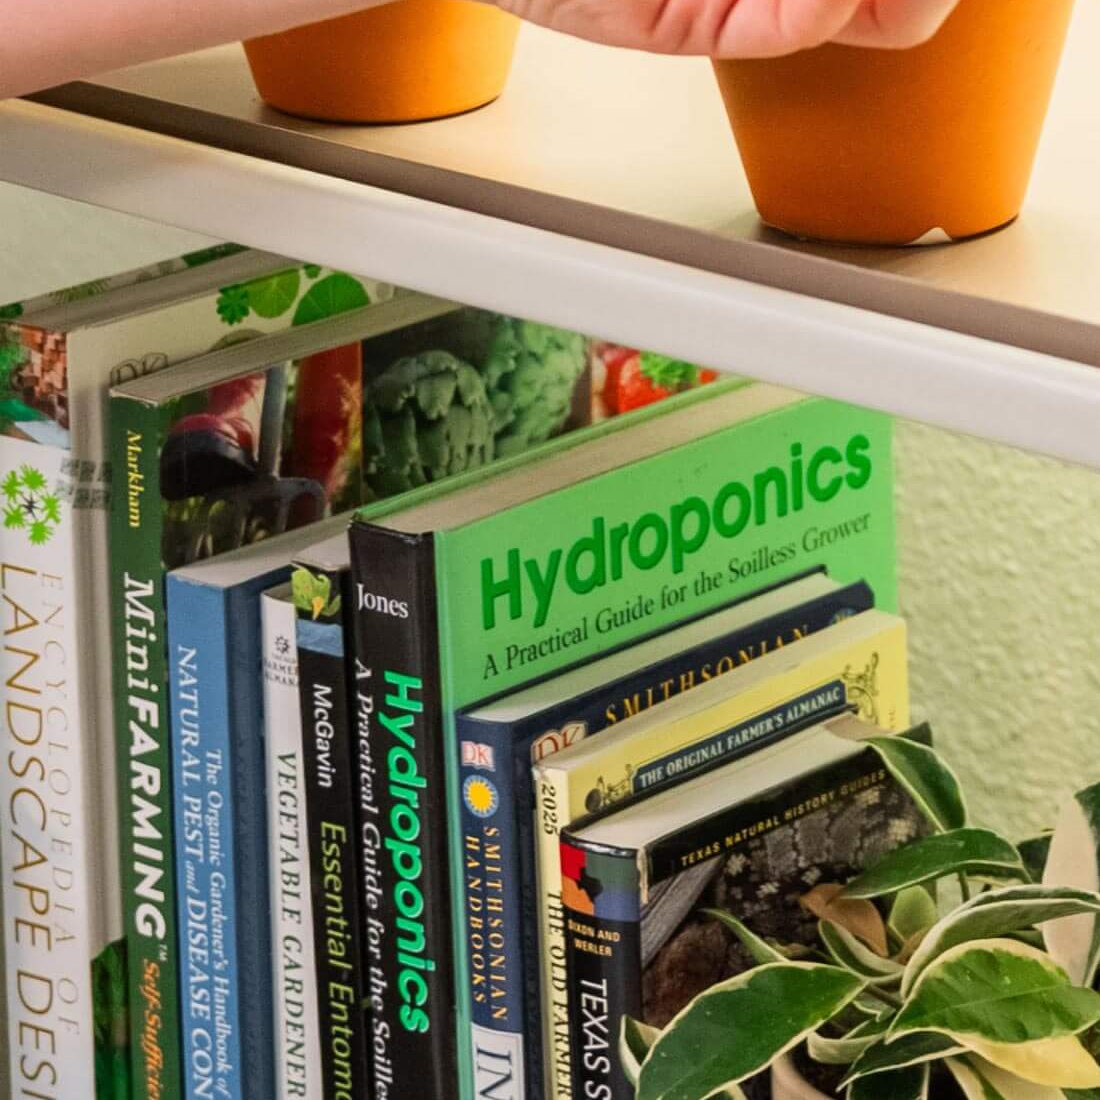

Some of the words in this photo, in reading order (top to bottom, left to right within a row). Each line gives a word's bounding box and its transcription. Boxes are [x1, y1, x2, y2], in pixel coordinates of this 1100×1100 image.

[127, 430, 144, 528] Markham
[480, 434, 873, 631] Hydroponics
[356, 582, 409, 619] Jones
[482, 654, 500, 680] A
[505, 617, 588, 670] Practical
[595, 594, 654, 634] Guide
[660, 582, 688, 611] for
[694, 569, 723, 597] the
[728, 541, 797, 584] Soilless
[802, 511, 872, 554] Grower
[178, 644, 201, 787] NATURAL
[355, 657, 372, 680] A
[0, 563, 51, 951] LANDSCAPE
[41, 573, 76, 942] ENCYCLOPEDIA
[206, 748, 223, 786] The
[312, 683, 336, 788] McGavin
[357, 691, 380, 814] Practical
[463, 742, 490, 766] DK
[639, 763, 664, 788] THE
[666, 738, 726, 775] ORIGINAL
[727, 711, 785, 749] FARMER'S
[786, 686, 842, 723] ALMANAC
[183, 794, 205, 863] PEST
[205, 790, 225, 867] Organic
[278, 752, 302, 925] VEGETABLE
[378, 670, 435, 1034] Hydroponics
[541, 783, 561, 837] 2025
[680, 841, 721, 867] TEXAS
[724, 816, 780, 847] NATURAL
[784, 789, 835, 820] HISTORY
[840, 769, 886, 795] GUIDES
[185, 860, 200, 894] and
[320, 821, 353, 969] Essential
[362, 822, 384, 909] Guide
[547, 893, 566, 936] THE
[187, 896, 211, 1020] DISEASE
[209, 871, 229, 970] Gardener's
[367, 917, 385, 960] for
[465, 835, 487, 1003] HANDBOOKS
[484, 826, 508, 1021] SMITHSONIAN
[568, 918, 595, 937] DIXON
[597, 929, 621, 942] AND
[57, 977, 80, 1035] OF
[282, 934, 307, 1099] GARDENER
[370, 967, 388, 1010] the
[550, 946, 569, 993] OLD
[213, 975, 232, 1073] Handbook
[580, 979, 610, 1074] TEXAS
[215, 1078, 232, 1099] of
